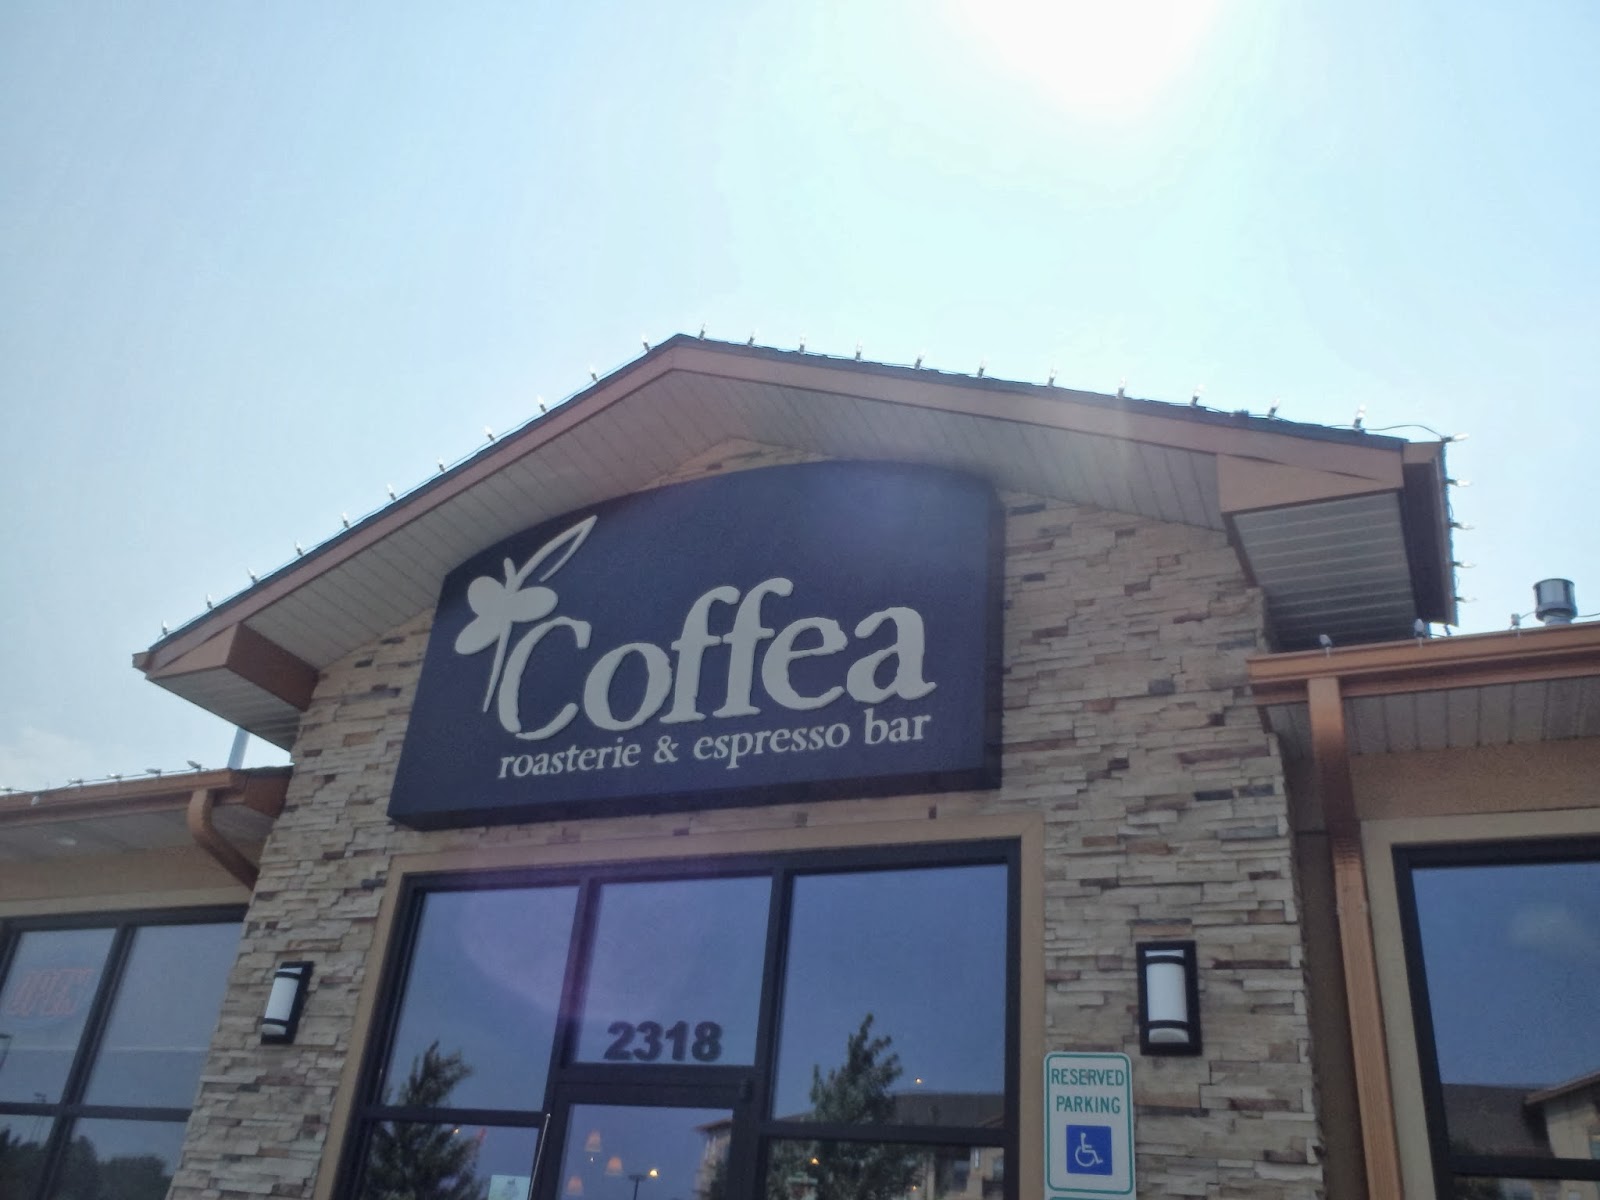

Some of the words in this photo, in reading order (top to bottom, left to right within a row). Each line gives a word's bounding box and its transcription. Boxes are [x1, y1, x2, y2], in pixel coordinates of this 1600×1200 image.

[498, 577, 937, 740] Coffea
[498, 737, 642, 778] roasterie
[653, 735, 680, 763] &
[693, 723, 850, 769] espresso
[864, 707, 931, 745] bar
[603, 1020, 723, 1062] 2318
[1051, 1068, 1124, 1086] RESERVED
[1056, 1096, 1120, 1114] PARKING
